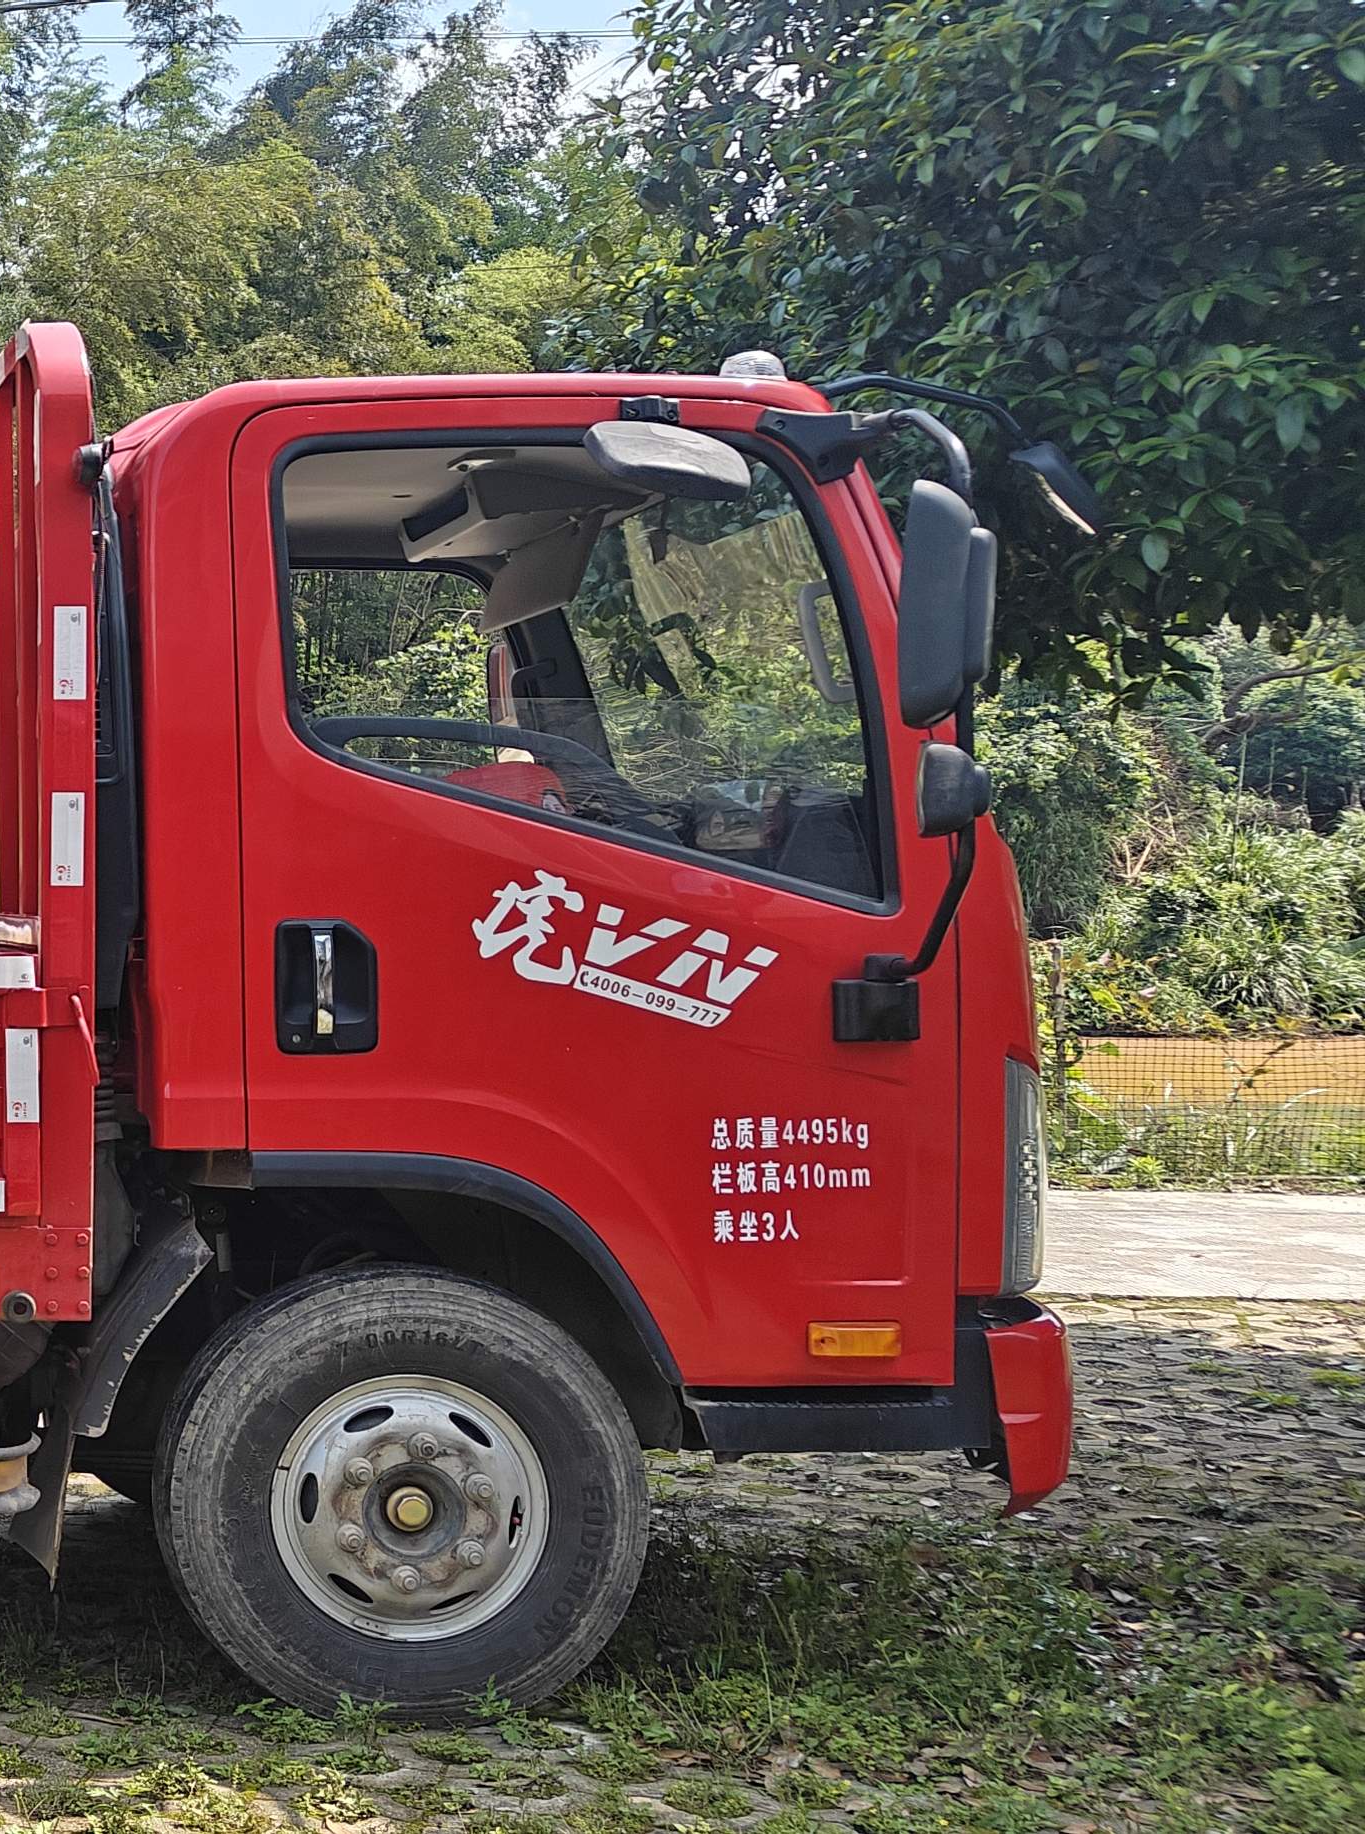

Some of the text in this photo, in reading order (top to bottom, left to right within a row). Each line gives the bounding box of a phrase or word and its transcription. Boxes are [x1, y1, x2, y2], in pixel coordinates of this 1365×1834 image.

[590, 974, 722, 1026] 4006-099-777
[710, 1116, 869, 1150] 总质量4495kg
[711, 1160, 871, 1194] 栏板高410mm
[713, 1209, 800, 1243] 乘坐3人
